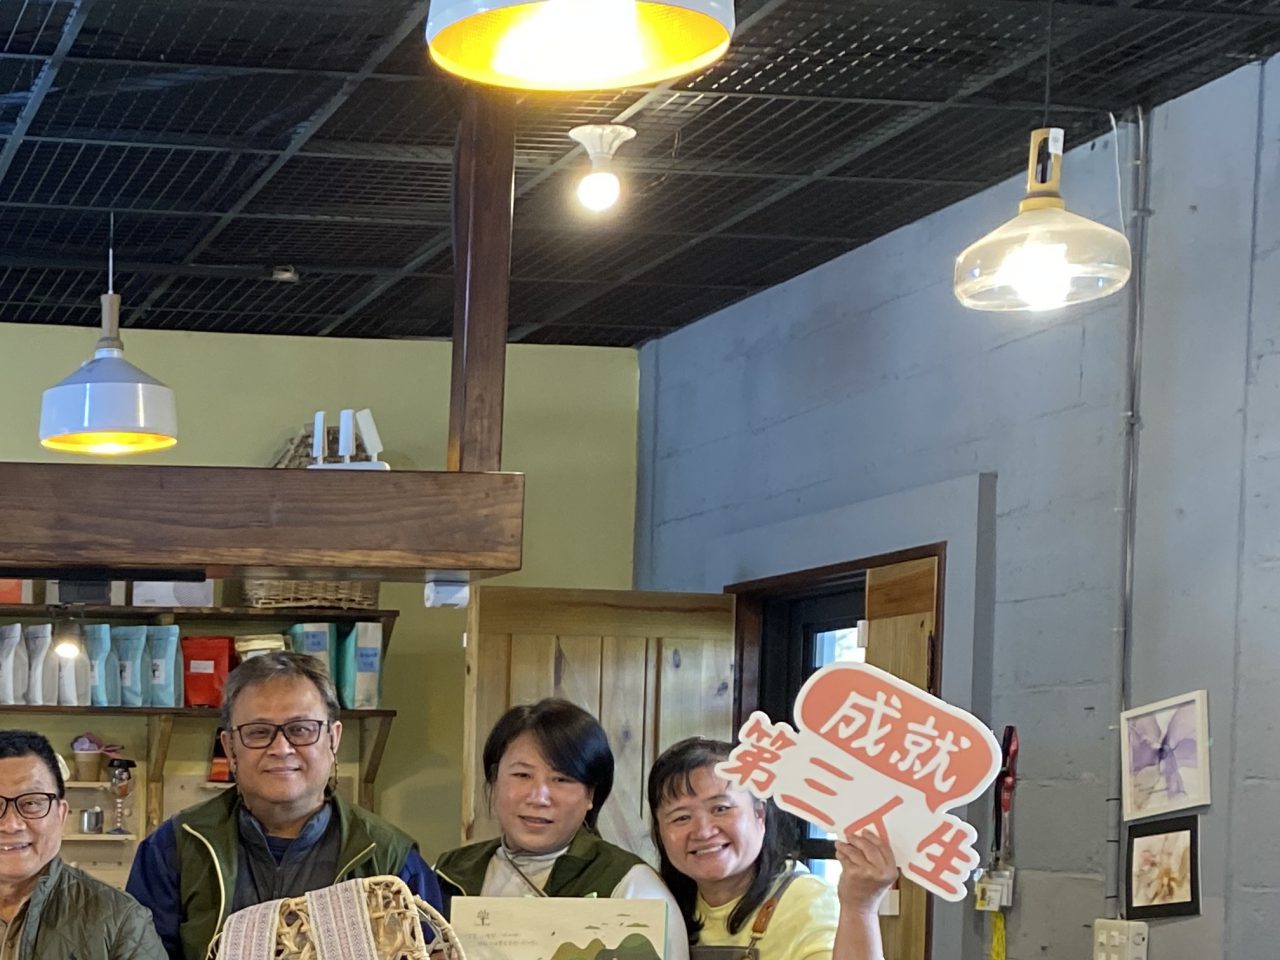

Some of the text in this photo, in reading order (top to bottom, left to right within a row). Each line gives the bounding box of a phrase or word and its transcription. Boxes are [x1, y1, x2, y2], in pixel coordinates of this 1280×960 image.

[722, 719, 971, 895] 第三人生
[820, 691, 971, 793] 成就
